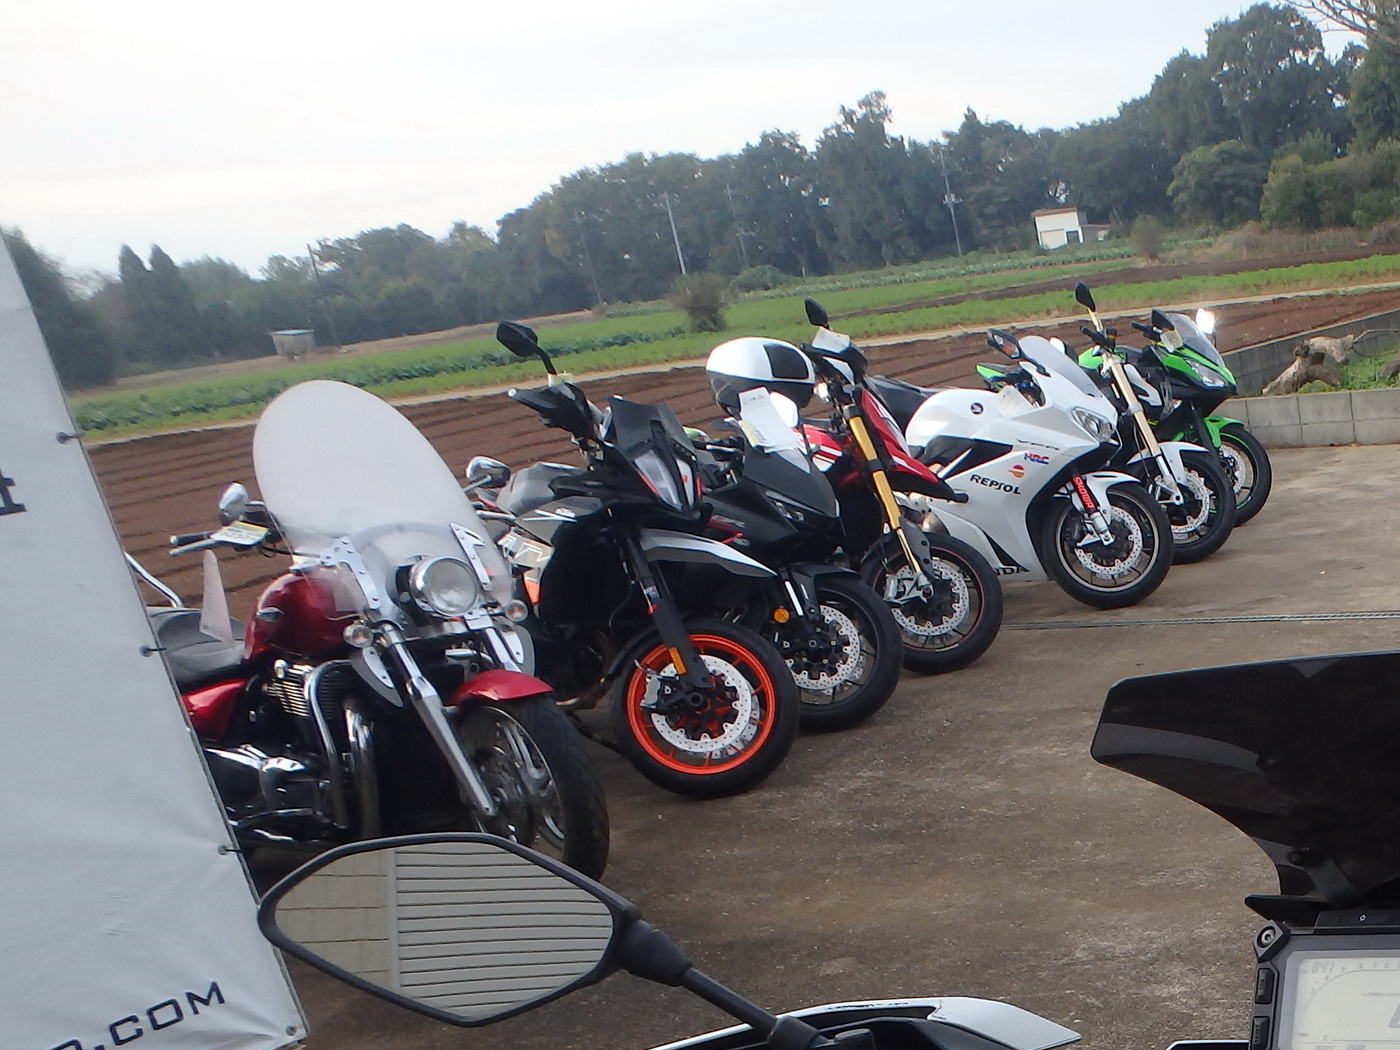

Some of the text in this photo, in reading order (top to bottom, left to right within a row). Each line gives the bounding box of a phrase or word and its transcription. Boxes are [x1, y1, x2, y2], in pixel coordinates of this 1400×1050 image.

[1024, 452, 1050, 465] HRC
[969, 474, 1021, 495] REPSOL
[1072, 476, 1095, 509] SHOWA
